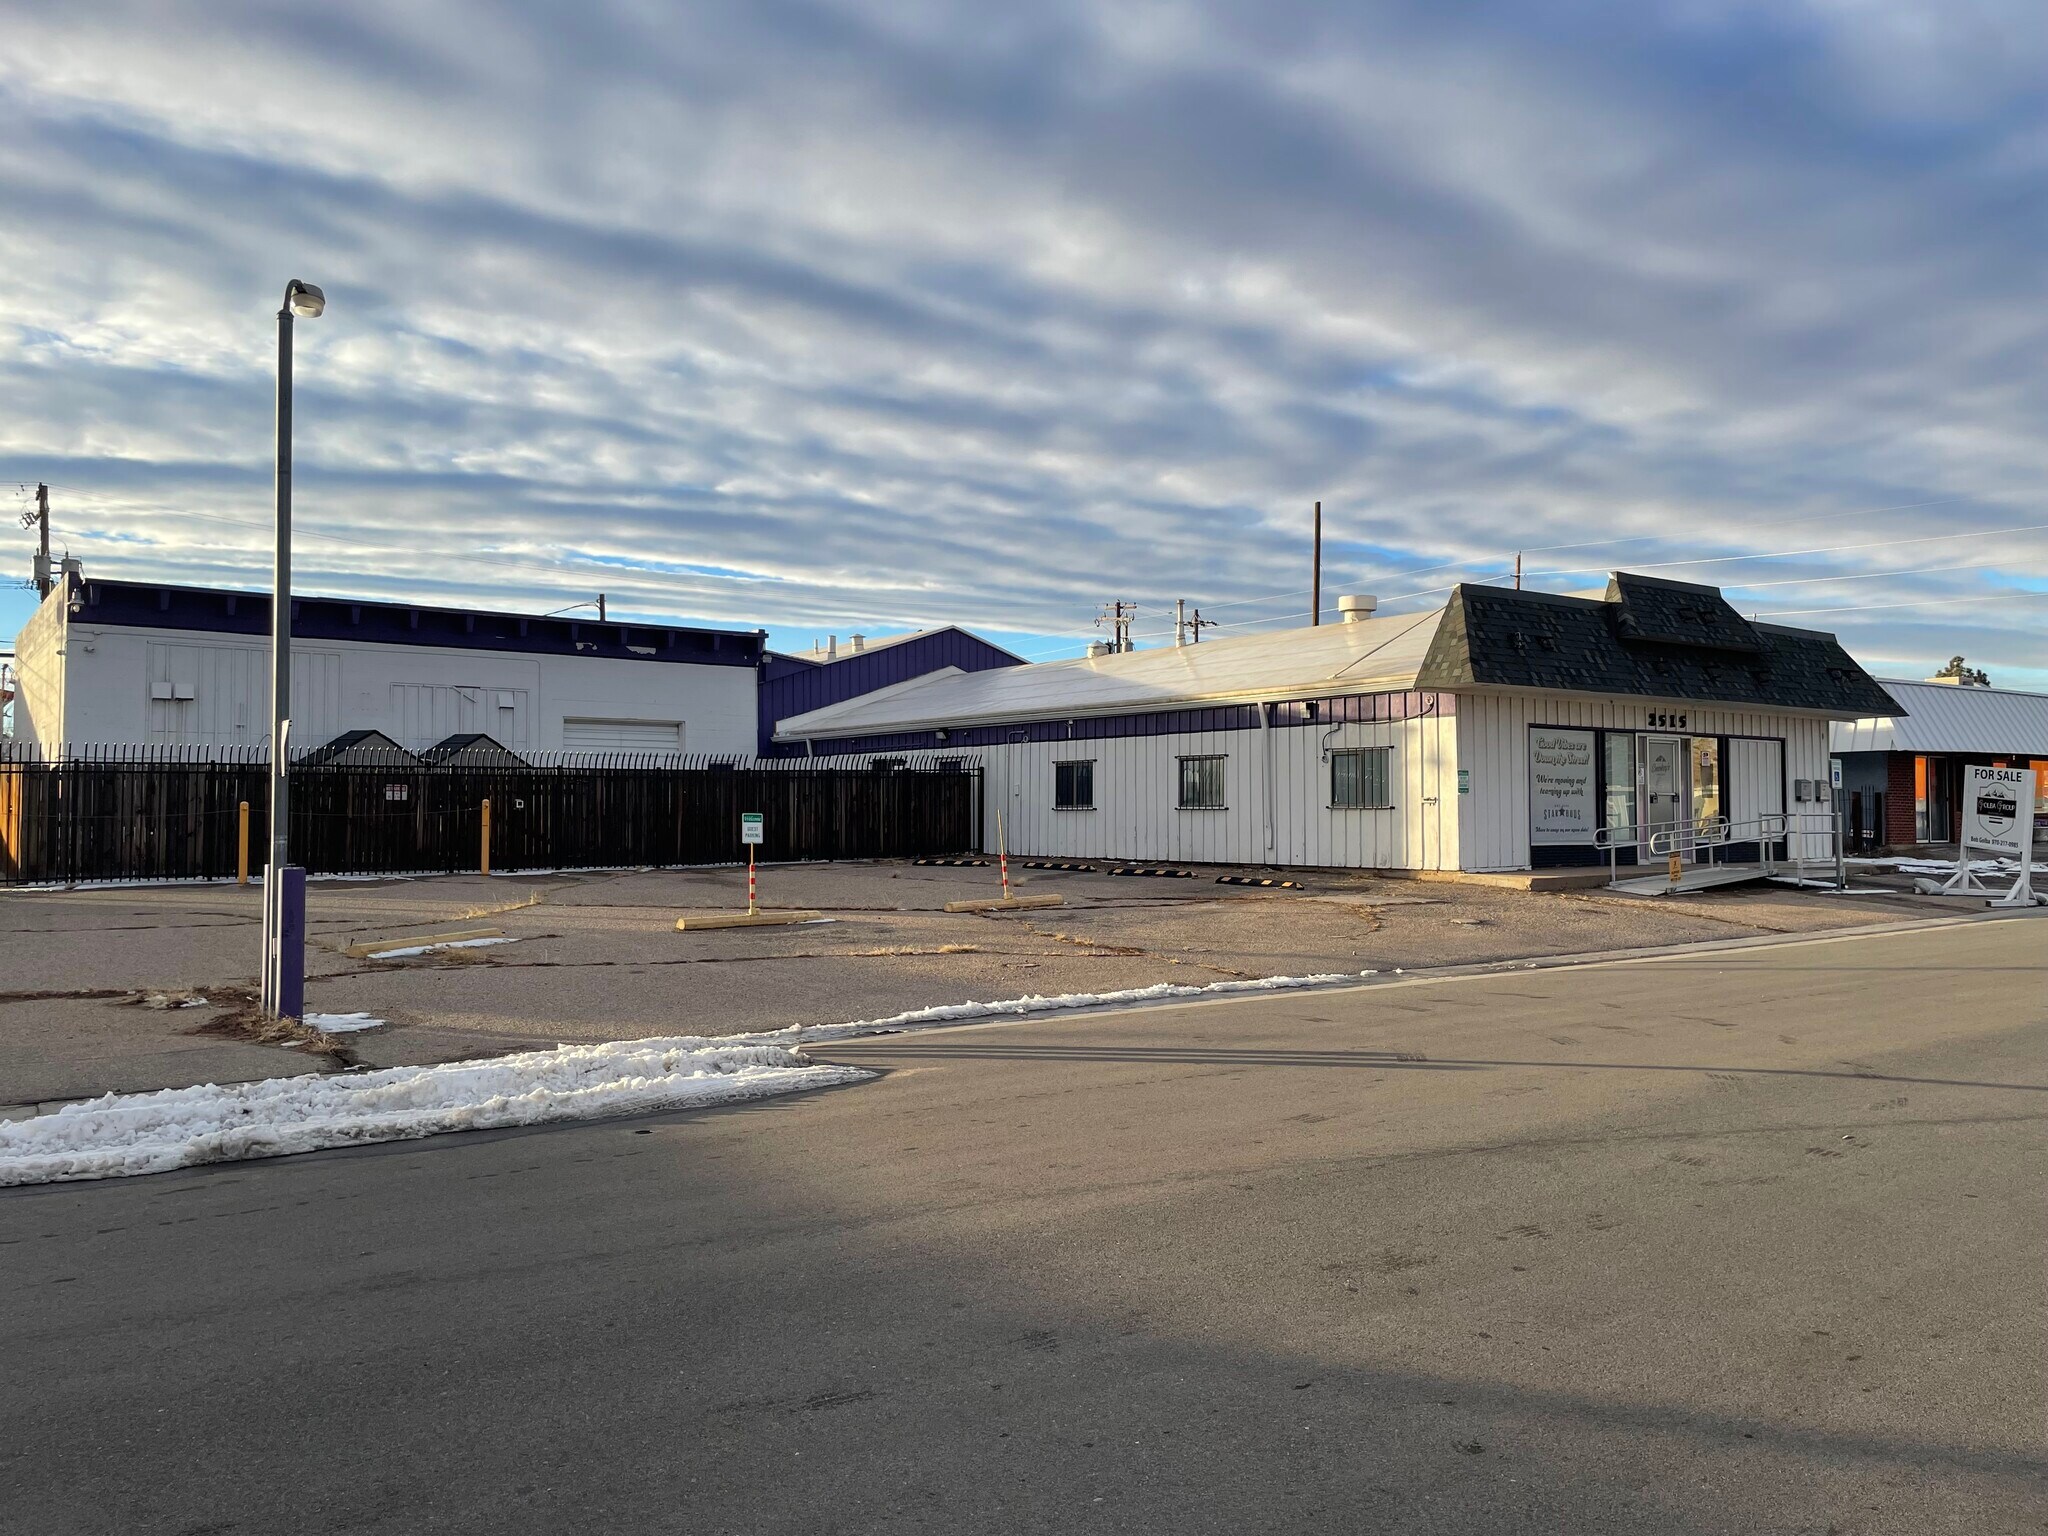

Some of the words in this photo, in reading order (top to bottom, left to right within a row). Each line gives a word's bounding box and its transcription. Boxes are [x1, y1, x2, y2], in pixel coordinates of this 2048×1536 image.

[1648, 713, 1686, 728] 2515
[1536, 737, 1556, 749] Good
[1556, 738, 1575, 750] Vibes
[1576, 742, 1587, 751] are
[1536, 774, 1553, 783] We're
[1555, 776, 1575, 787] moving
[1576, 777, 1587, 785] and
[1974, 769, 1994, 780] FOR
[1997, 770, 2022, 782] SALE
[1571, 788, 1584, 796] with
